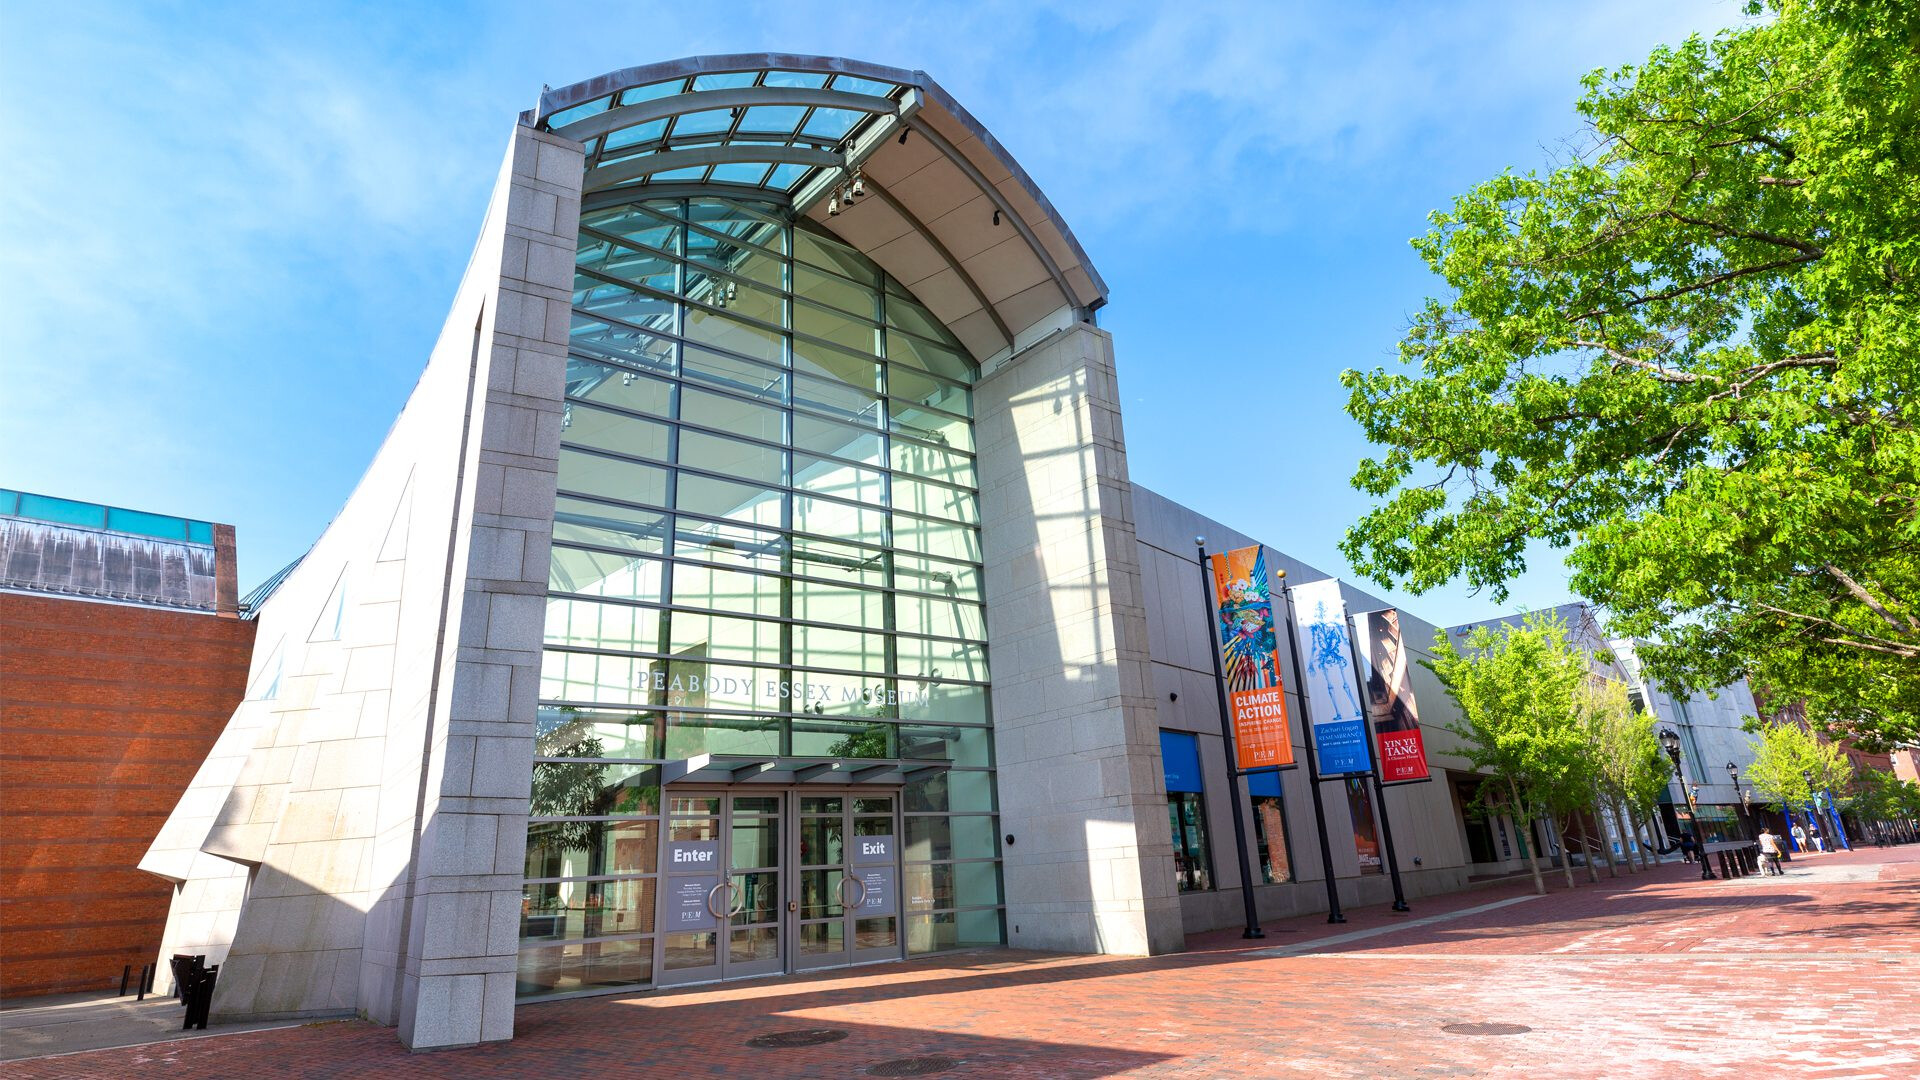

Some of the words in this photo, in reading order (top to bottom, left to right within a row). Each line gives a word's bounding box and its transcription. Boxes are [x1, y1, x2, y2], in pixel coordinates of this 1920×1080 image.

[637, 671, 754, 695] PEABODY
[766, 681, 832, 701] ESSEX
[841, 687, 930, 708] MUSEUM
[1236, 692, 1280, 707] CLIMATE
[1238, 704, 1282, 720] ACTION
[1263, 717, 1282, 725] CHANGE
[1385, 740, 1401, 748] YIN
[1403, 738, 1417, 746] YU
[1385, 745, 1418, 757] TANG
[674, 848, 713, 863] Enter
[862, 842, 886, 855] Exit
